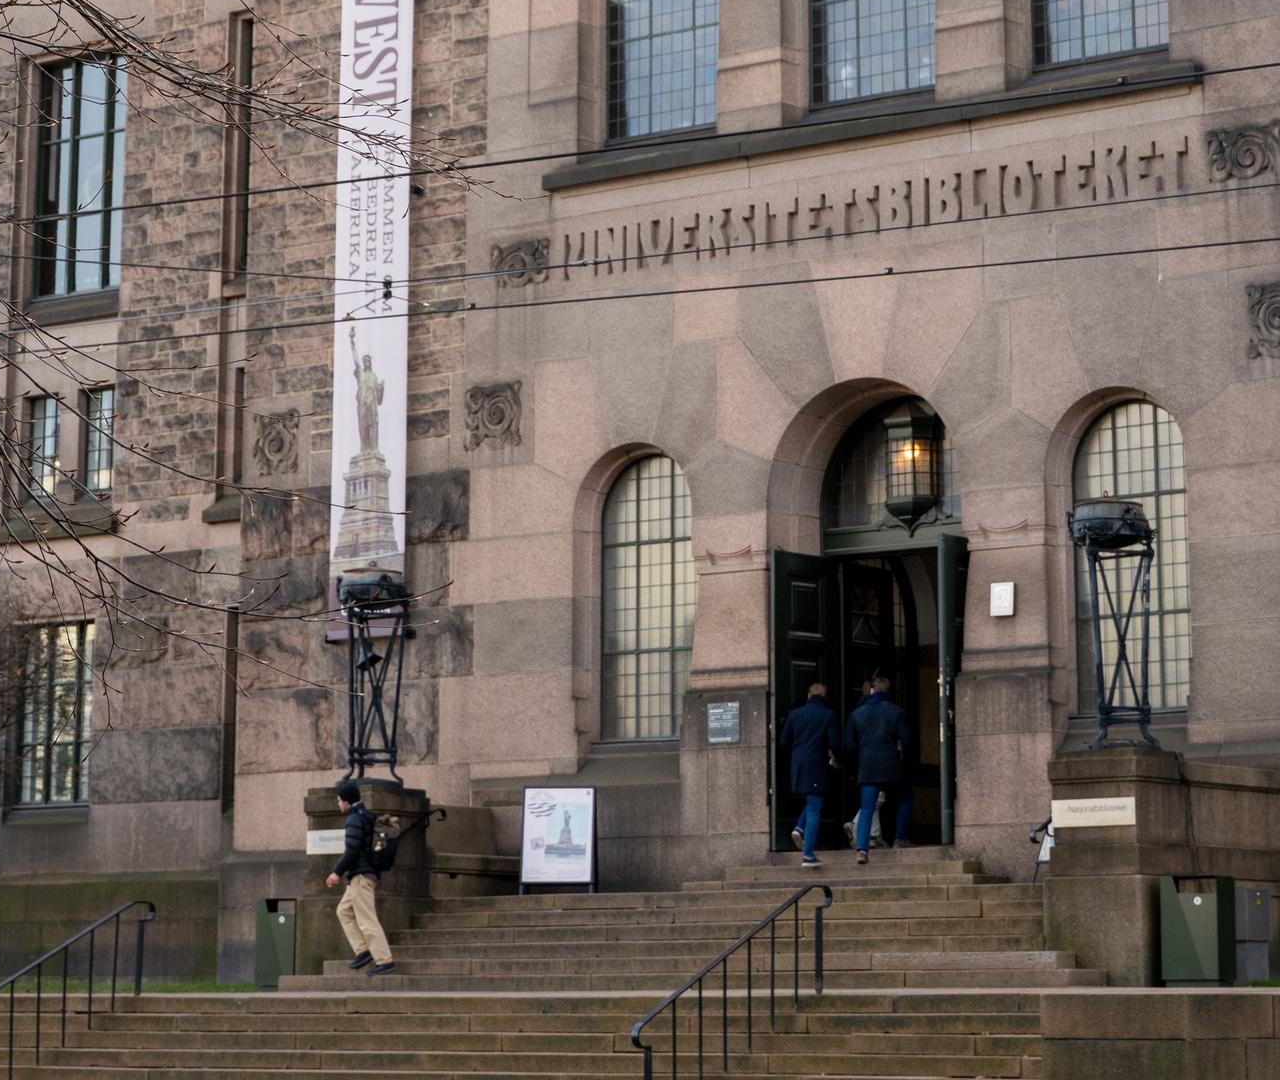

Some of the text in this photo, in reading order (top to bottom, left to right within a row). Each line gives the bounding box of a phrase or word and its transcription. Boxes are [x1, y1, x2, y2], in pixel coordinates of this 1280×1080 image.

[349, 156, 361, 278] AMERIKA
[366, 174, 378, 262] BEDRE
[383, 131, 395, 264] RMMEN
[365, 272, 377, 314] LIV
